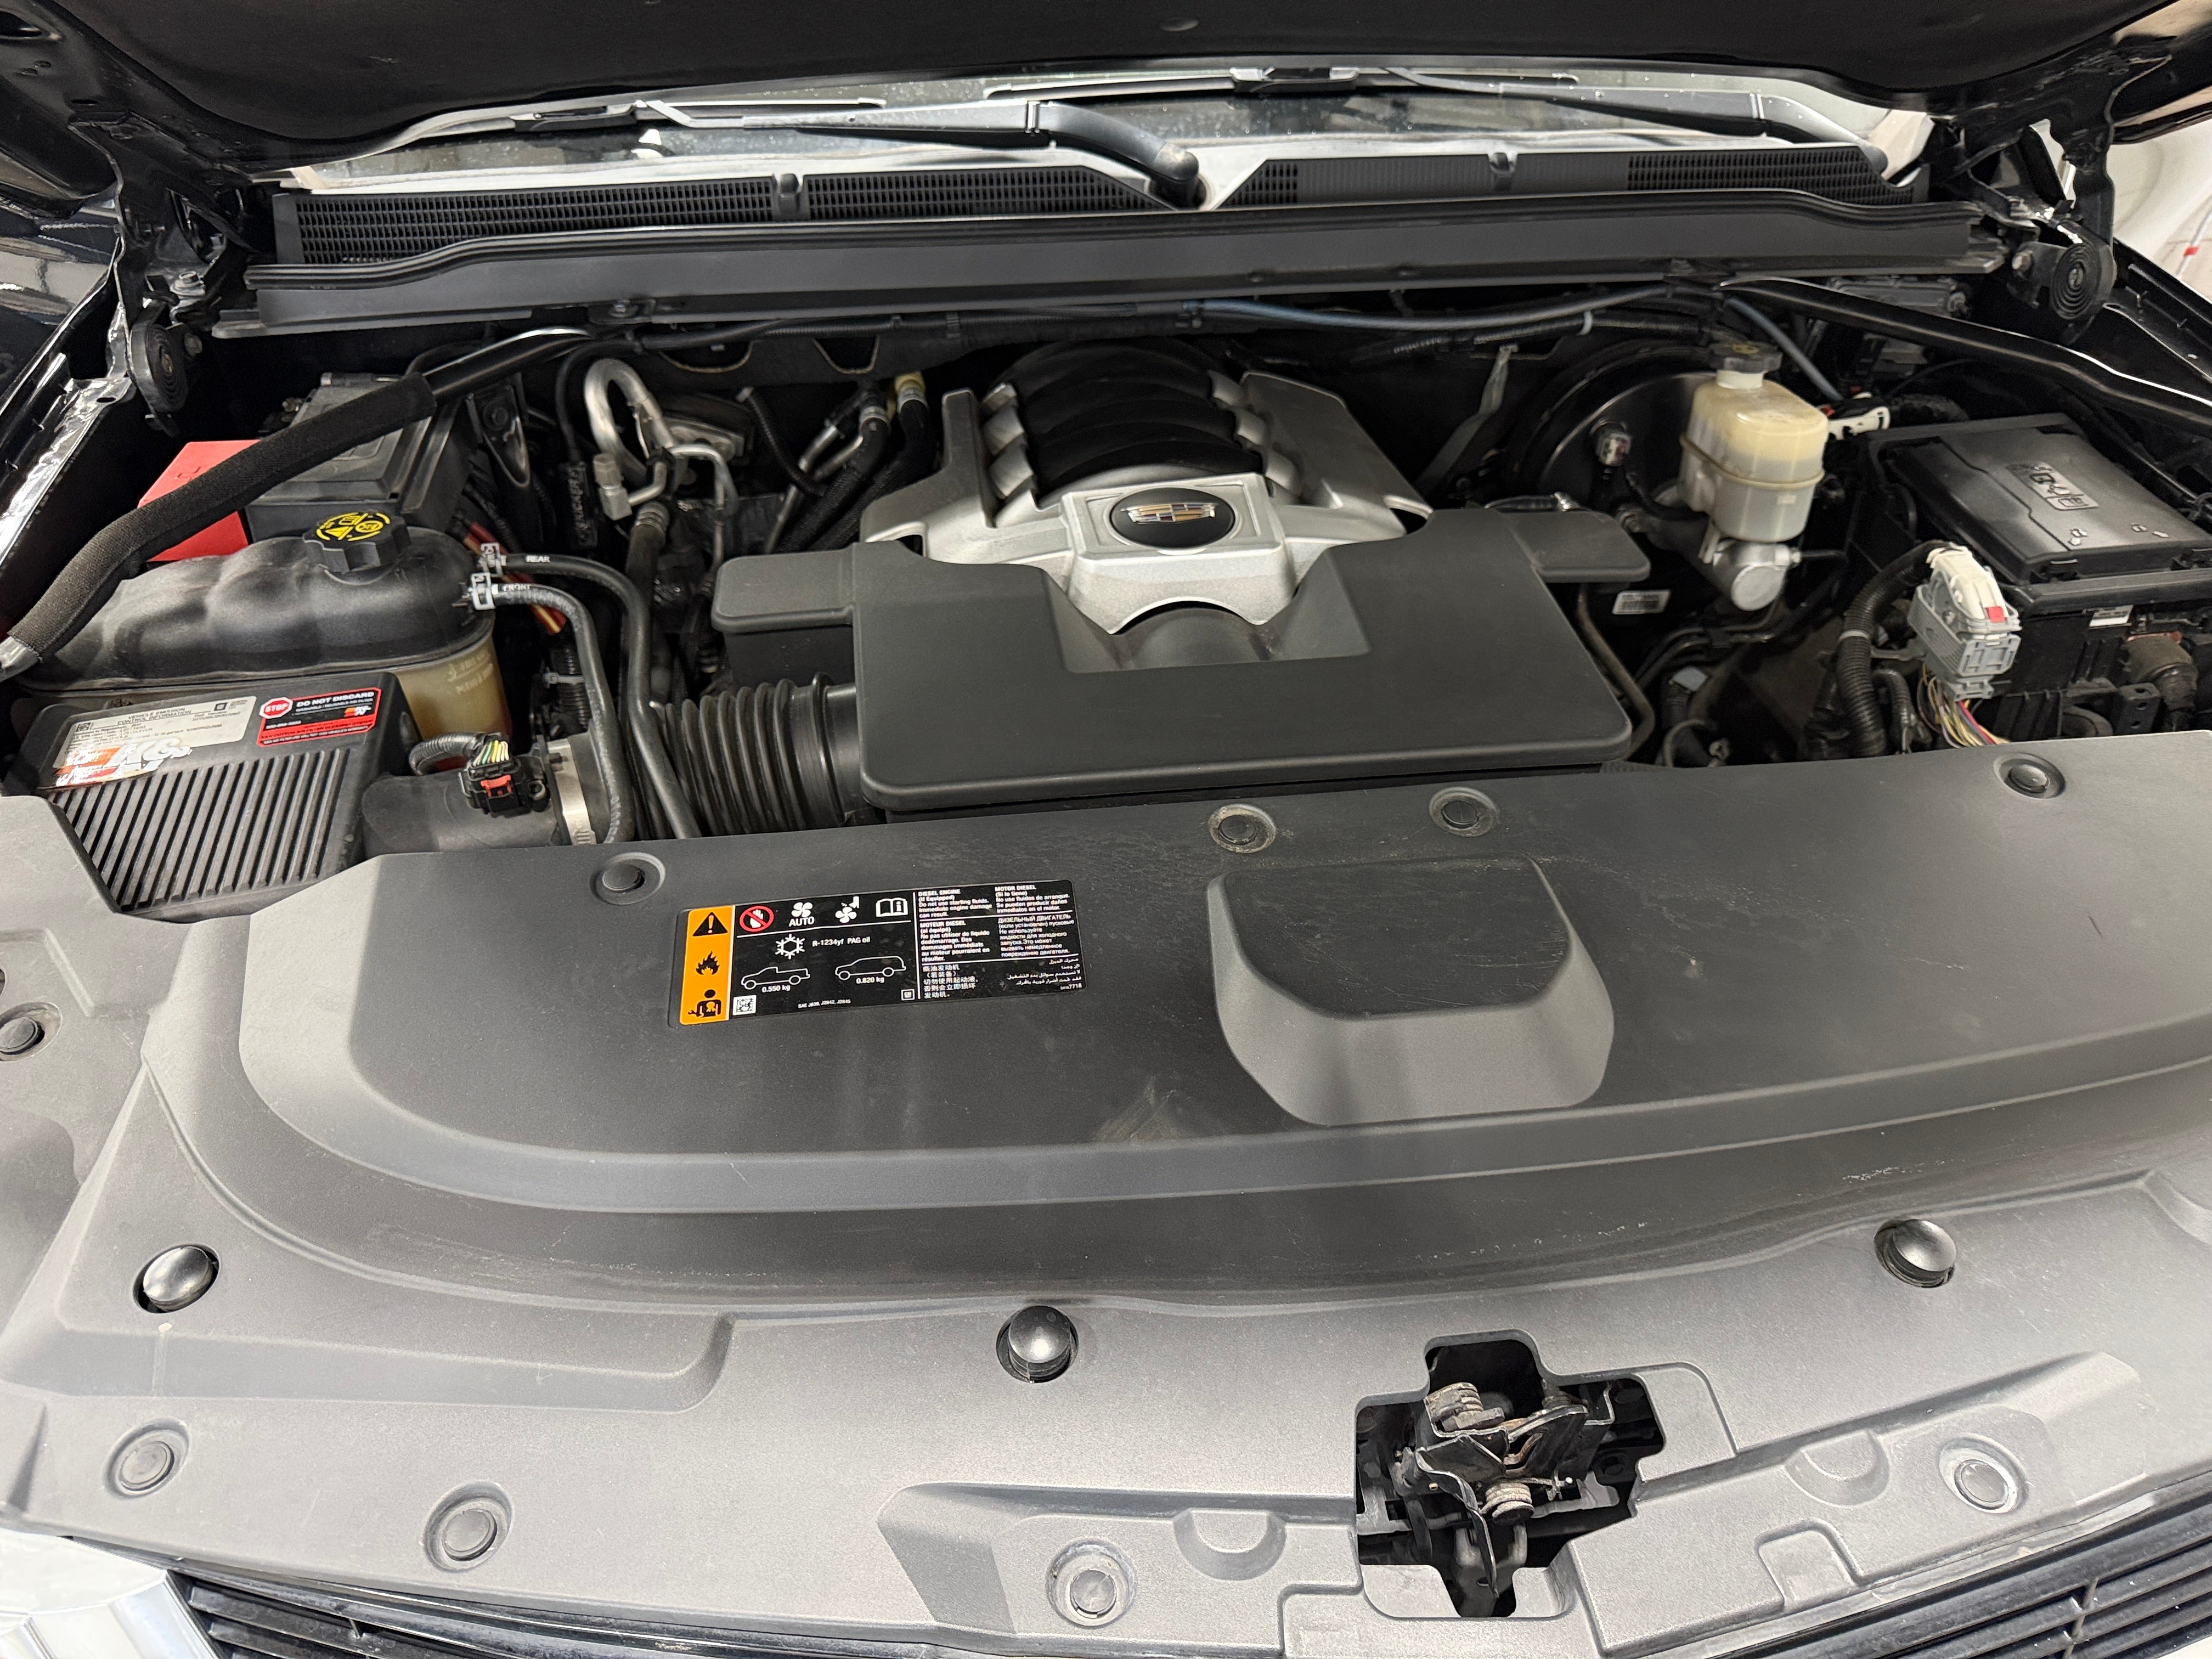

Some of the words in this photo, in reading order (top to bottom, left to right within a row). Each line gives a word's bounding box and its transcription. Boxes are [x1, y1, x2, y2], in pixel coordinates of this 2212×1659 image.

[332, 692, 374, 702] DISCARD
[265, 703, 289, 713] STOP
[788, 916, 815, 927] AUTO
[812, 938, 844, 947] R-1234yf
